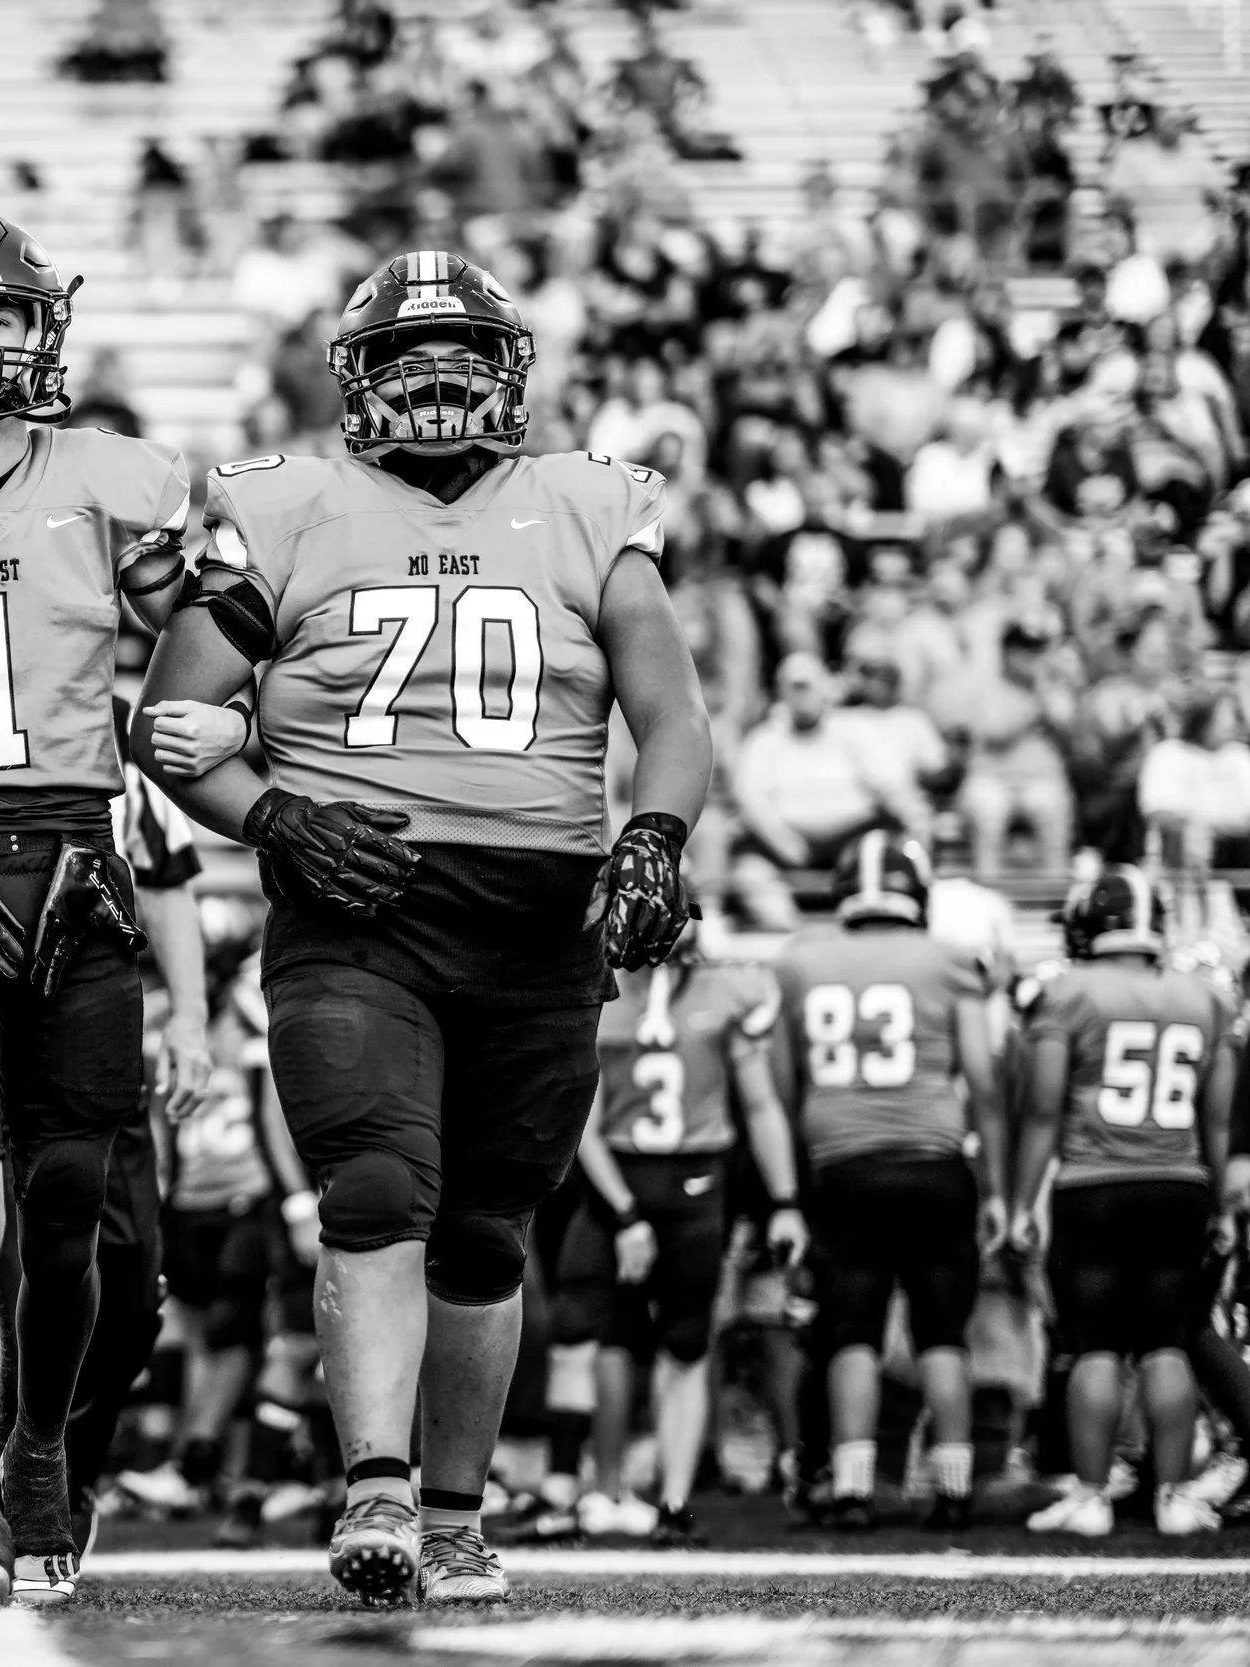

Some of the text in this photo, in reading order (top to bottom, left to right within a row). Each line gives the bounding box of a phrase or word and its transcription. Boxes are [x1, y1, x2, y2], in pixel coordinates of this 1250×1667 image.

[419, 409, 455, 417] Ridell
[407, 554, 480, 576] MO EAST
[344, 584, 544, 751] 70
[804, 983, 915, 1087] 83
[1097, 1020, 1204, 1130] 56
[632, 1051, 684, 1154] 3
